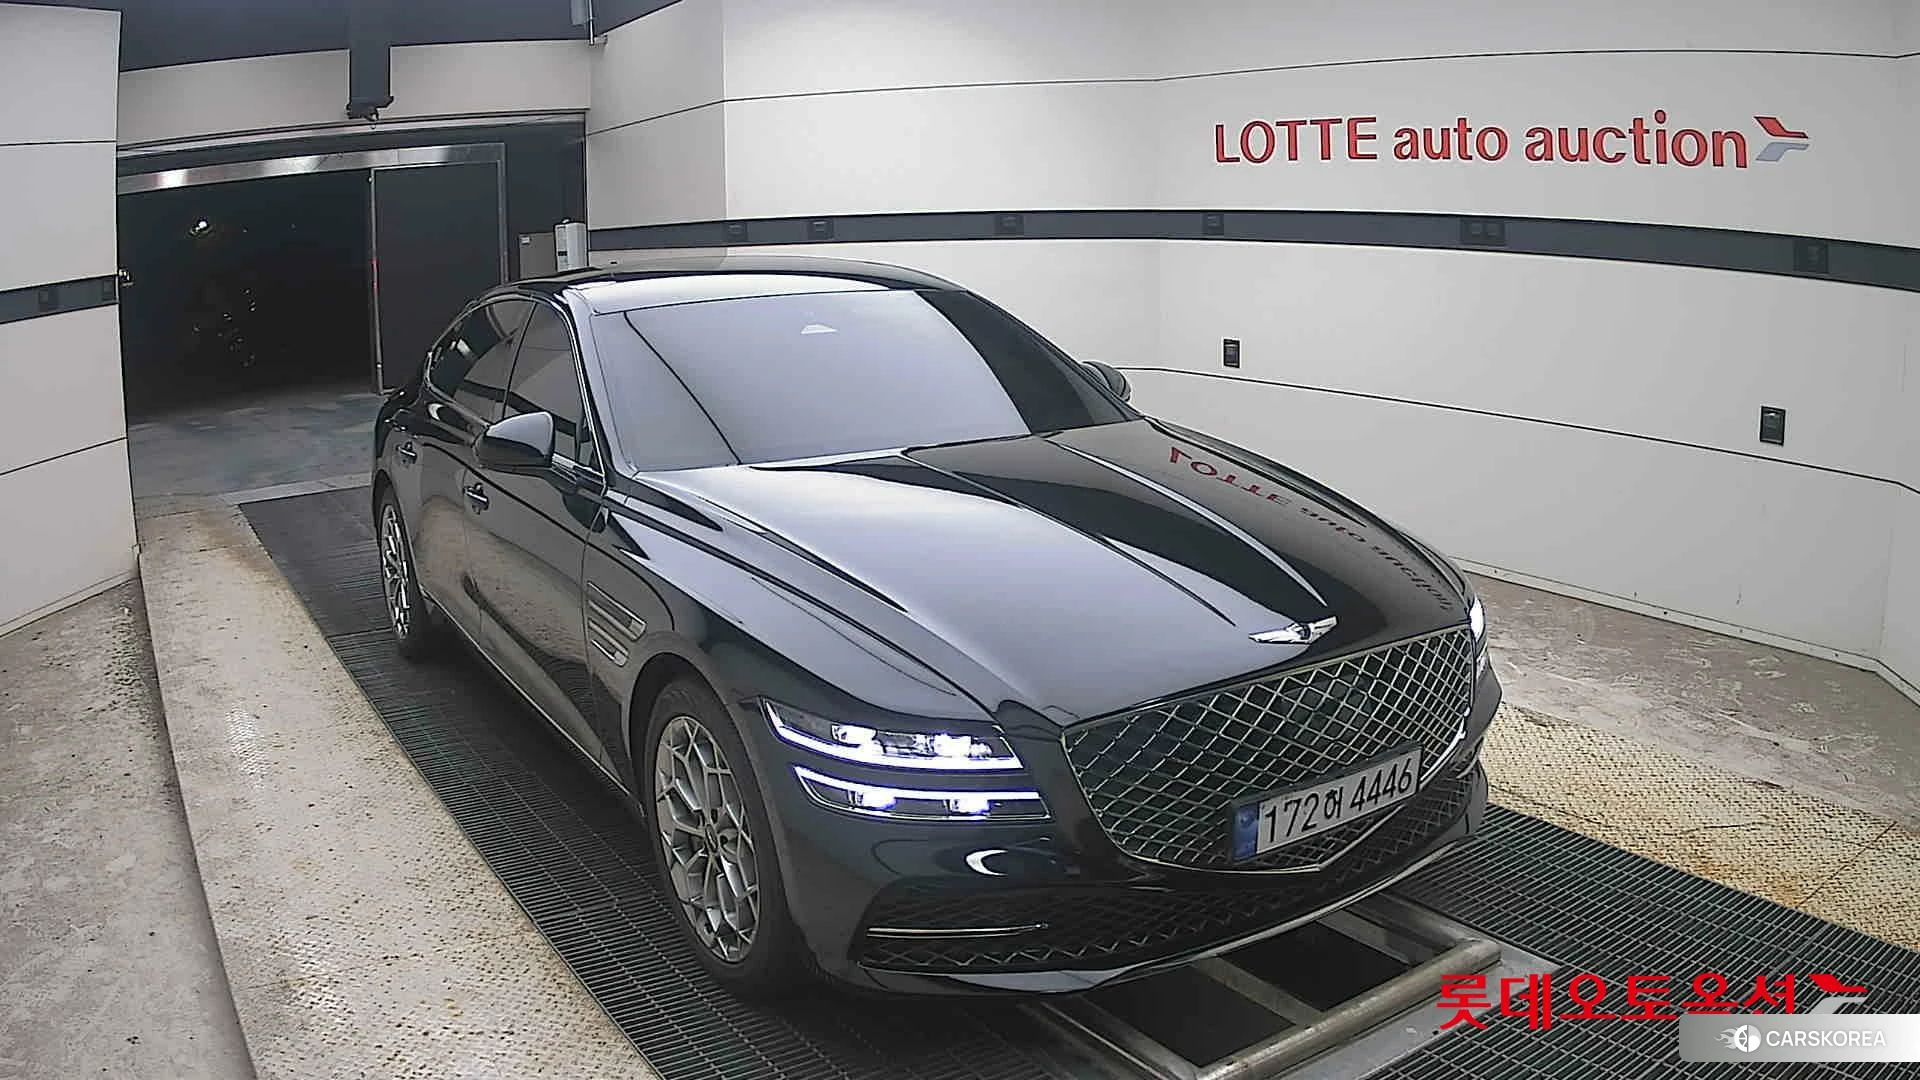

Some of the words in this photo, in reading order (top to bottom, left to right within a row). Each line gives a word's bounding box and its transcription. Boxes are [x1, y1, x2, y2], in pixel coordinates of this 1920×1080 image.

[1215, 116, 1378, 163] LOTTE
[1393, 117, 1509, 163] auto
[1525, 109, 1748, 169] auction
[1350, 758, 1413, 811] 4446
